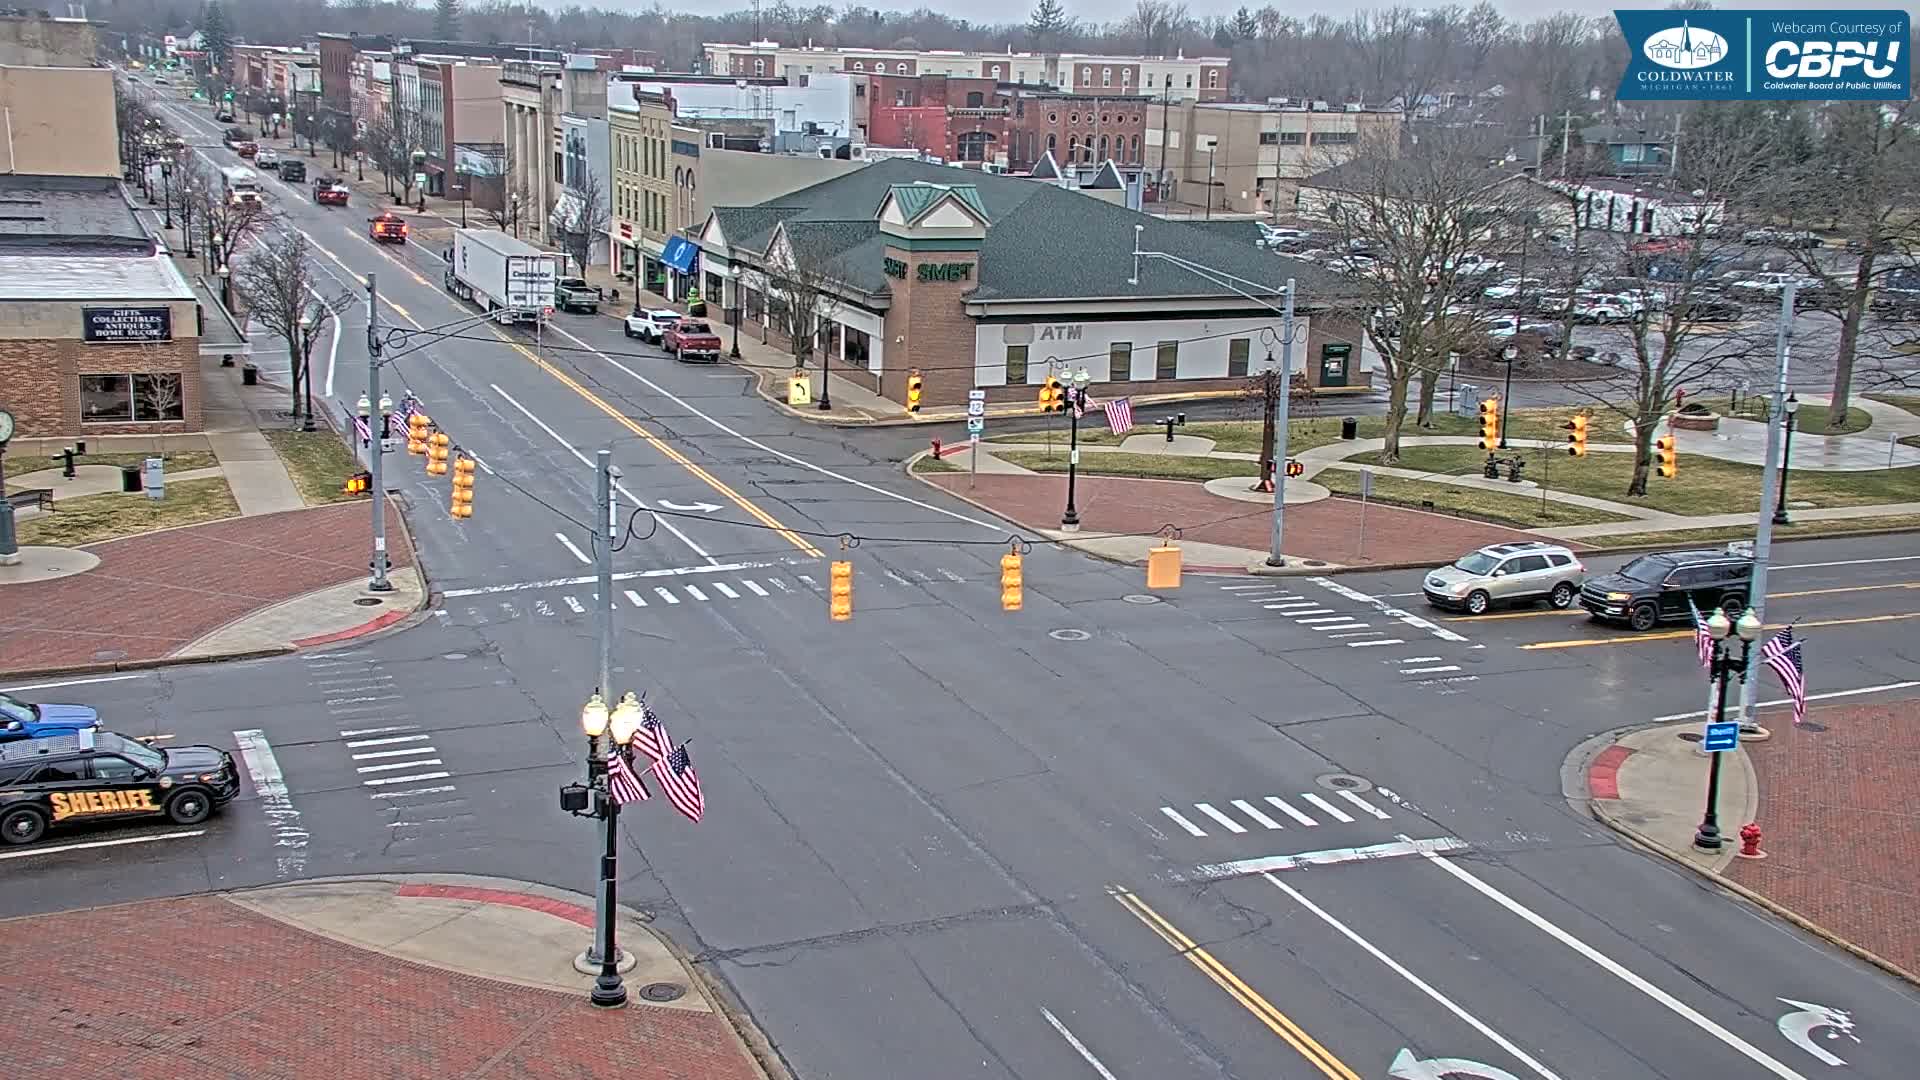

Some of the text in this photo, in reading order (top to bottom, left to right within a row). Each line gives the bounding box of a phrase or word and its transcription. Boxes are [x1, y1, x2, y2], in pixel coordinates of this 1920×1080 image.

[113, 309, 141, 317] GIFTS
[92, 316, 162, 324] COLLECTIBLES
[95, 329, 124, 337] HOME
[1039, 325, 1083, 341] ATM
[50, 789, 153, 813] SHERIFF
